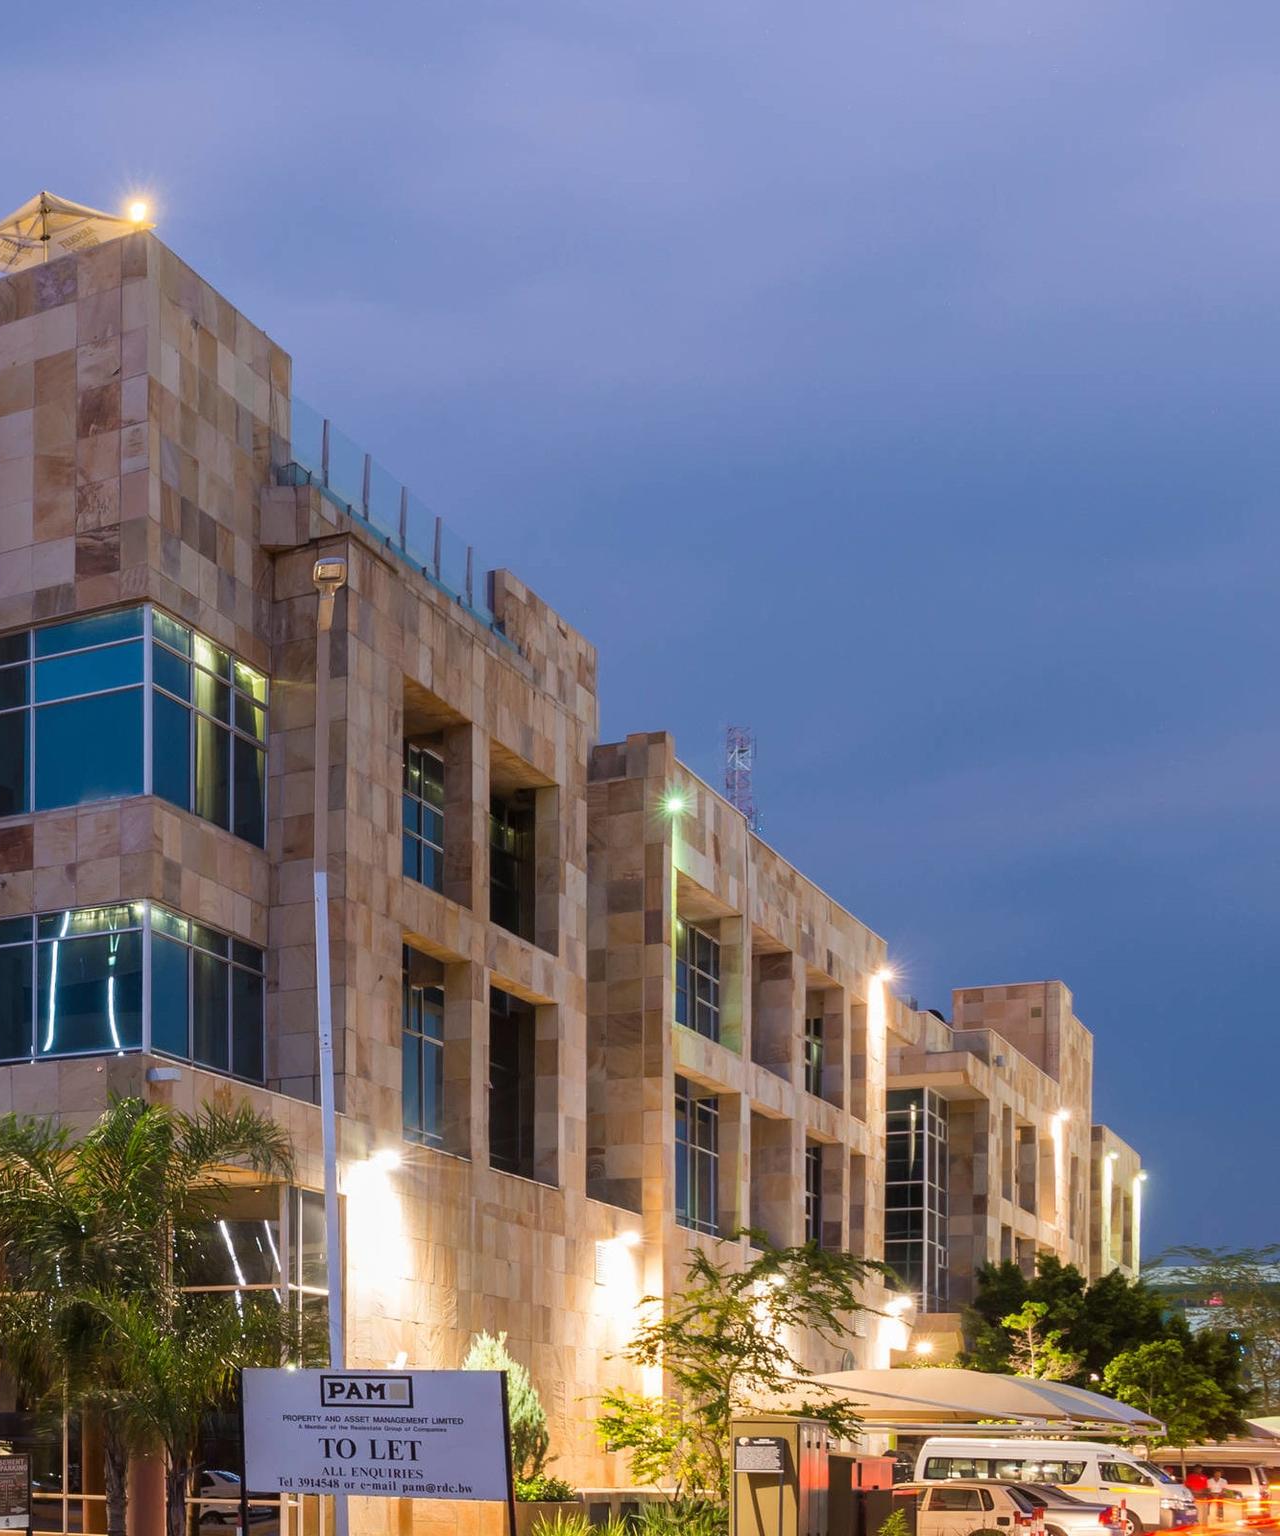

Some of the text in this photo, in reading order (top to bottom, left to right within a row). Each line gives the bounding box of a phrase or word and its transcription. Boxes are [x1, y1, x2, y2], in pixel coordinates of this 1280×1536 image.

[328, 1382, 386, 1400] PAM
[282, 1414, 321, 1422] PROPERTY
[373, 1416, 429, 1424] MANAGEMENT
[432, 1417, 464, 1425] LIMITED
[319, 1438, 422, 1461] TO LET
[322, 1466, 424, 1479] ALL ENQUIRIES
[278, 1477, 472, 1493] Tel 3914548 or e-mail pam@rdc.bw
